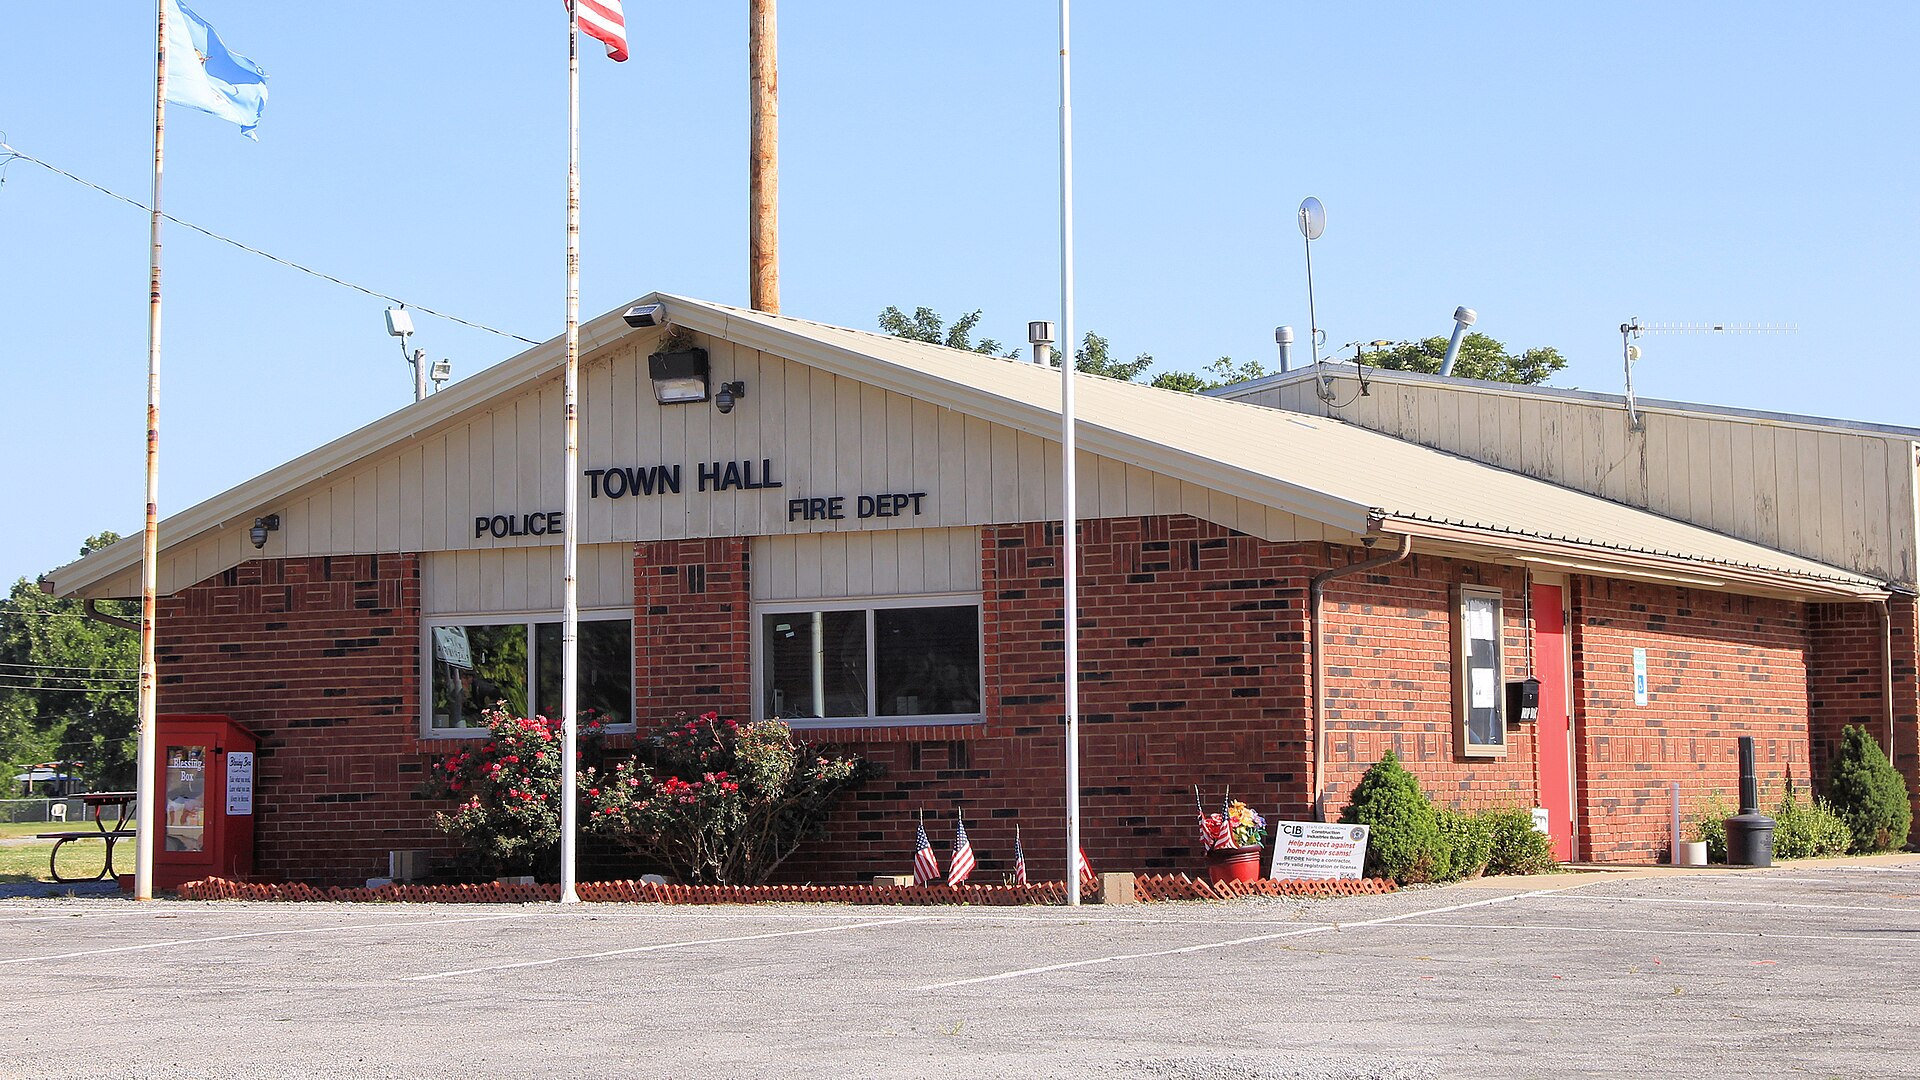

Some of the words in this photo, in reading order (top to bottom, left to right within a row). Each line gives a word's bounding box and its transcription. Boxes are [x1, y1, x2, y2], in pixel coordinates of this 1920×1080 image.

[584, 464, 681, 499] TOWN
[698, 459, 783, 492] HALL
[788, 496, 846, 522] FIRE
[857, 492, 927, 519] DEPT
[475, 511, 564, 538] POLICE
[173, 758, 202, 771] Blessing
[181, 771, 193, 781] Box
[1283, 825, 1302, 834] CIB
